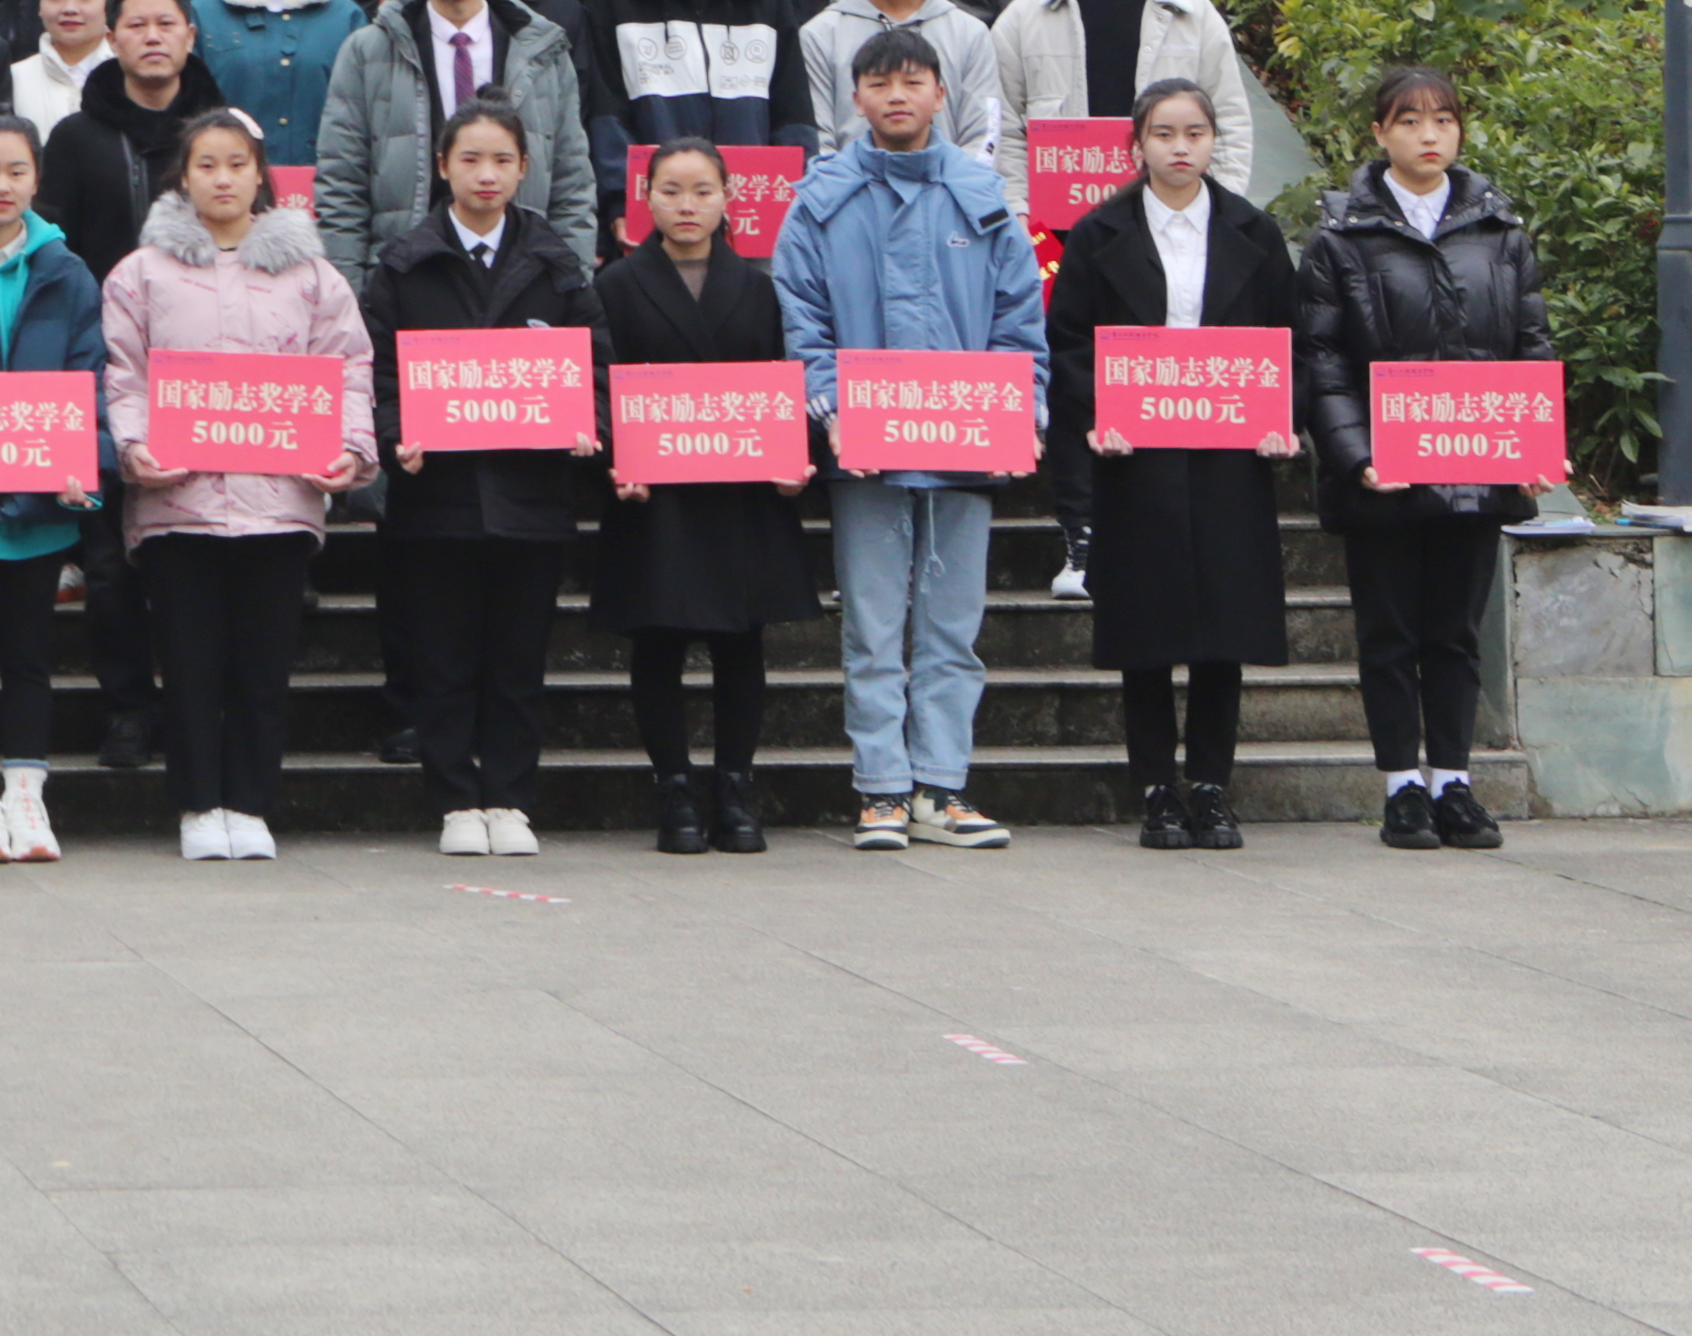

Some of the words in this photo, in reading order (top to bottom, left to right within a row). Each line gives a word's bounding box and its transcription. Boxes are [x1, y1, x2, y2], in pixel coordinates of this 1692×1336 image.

[1035, 145, 1138, 174] 国家励志
[408, 358, 582, 390] 国家励志奖学金
[1105, 355, 1280, 387] 国家励志奖学金
[157, 379, 333, 415] 国家励志奖学金
[446, 395, 551, 424] 5000元
[621, 391, 795, 423] 国家励志奖学金
[848, 379, 1023, 411] 国家励志奖学金
[1140, 394, 1246, 424] 5000元
[1381, 391, 1554, 423] 国家励志奖学金
[192, 420, 298, 450] 5000元
[658, 428, 763, 457] 5000元
[884, 418, 990, 447] 5000元
[1417, 429, 1522, 459] 5000元
